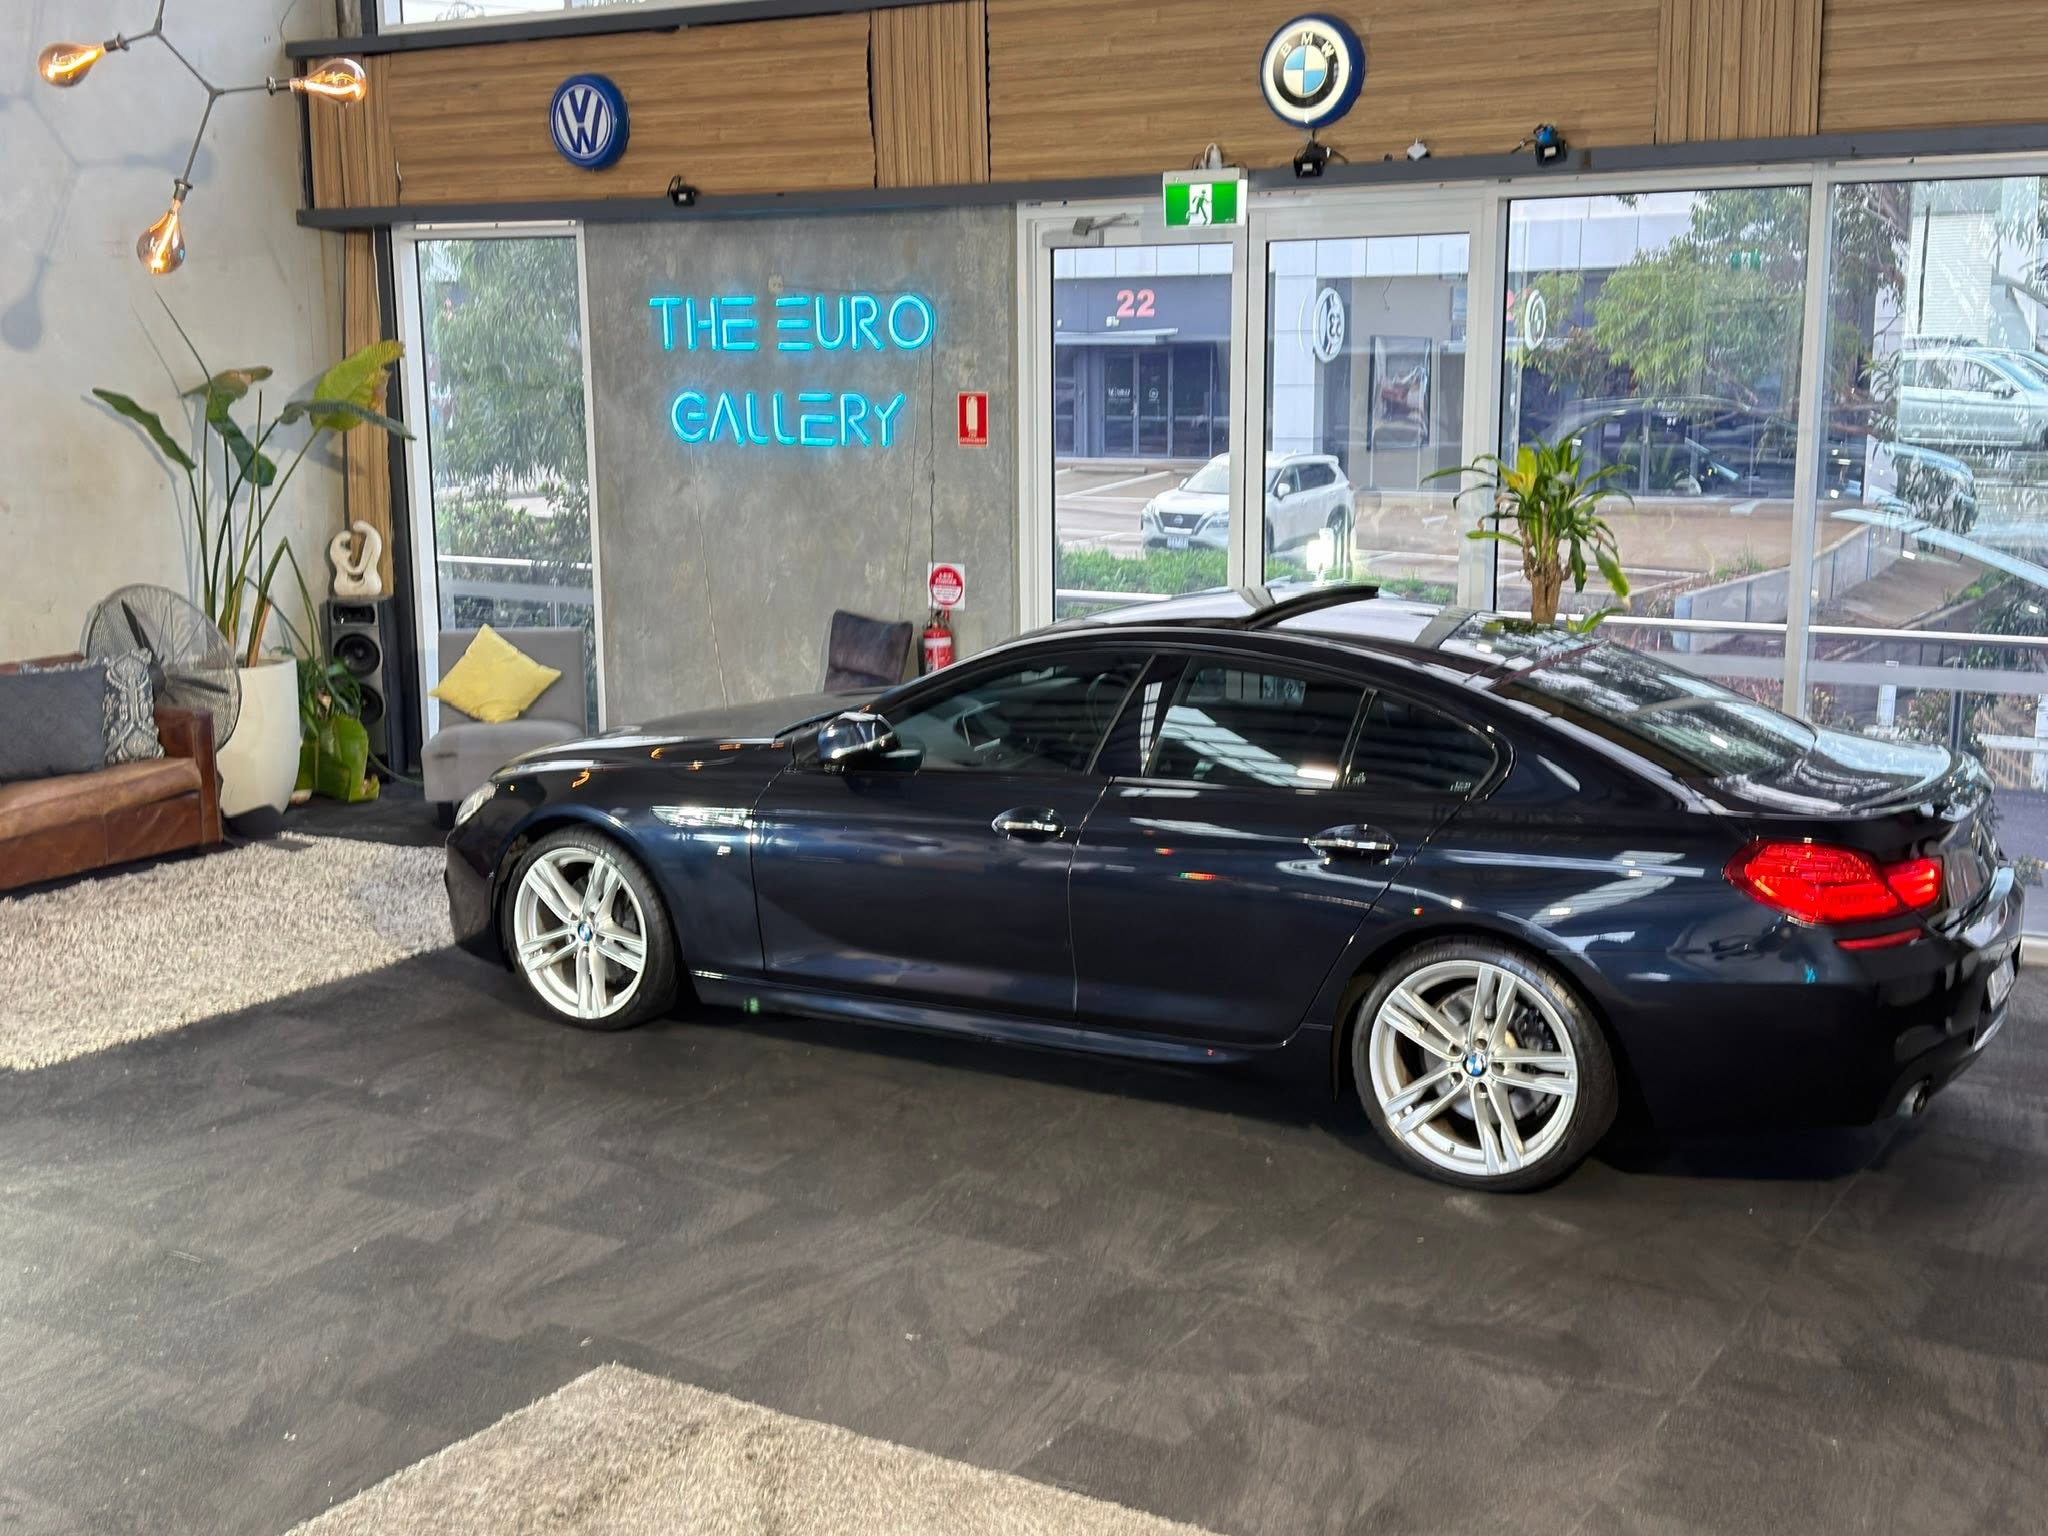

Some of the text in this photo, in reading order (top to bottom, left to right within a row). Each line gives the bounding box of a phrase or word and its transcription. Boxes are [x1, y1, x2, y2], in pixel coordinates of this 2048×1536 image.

[1280, 32, 1335, 60] BMW
[649, 294, 934, 351] THE EURO
[1116, 289, 1156, 318] 22
[671, 391, 906, 447] GALLERY
